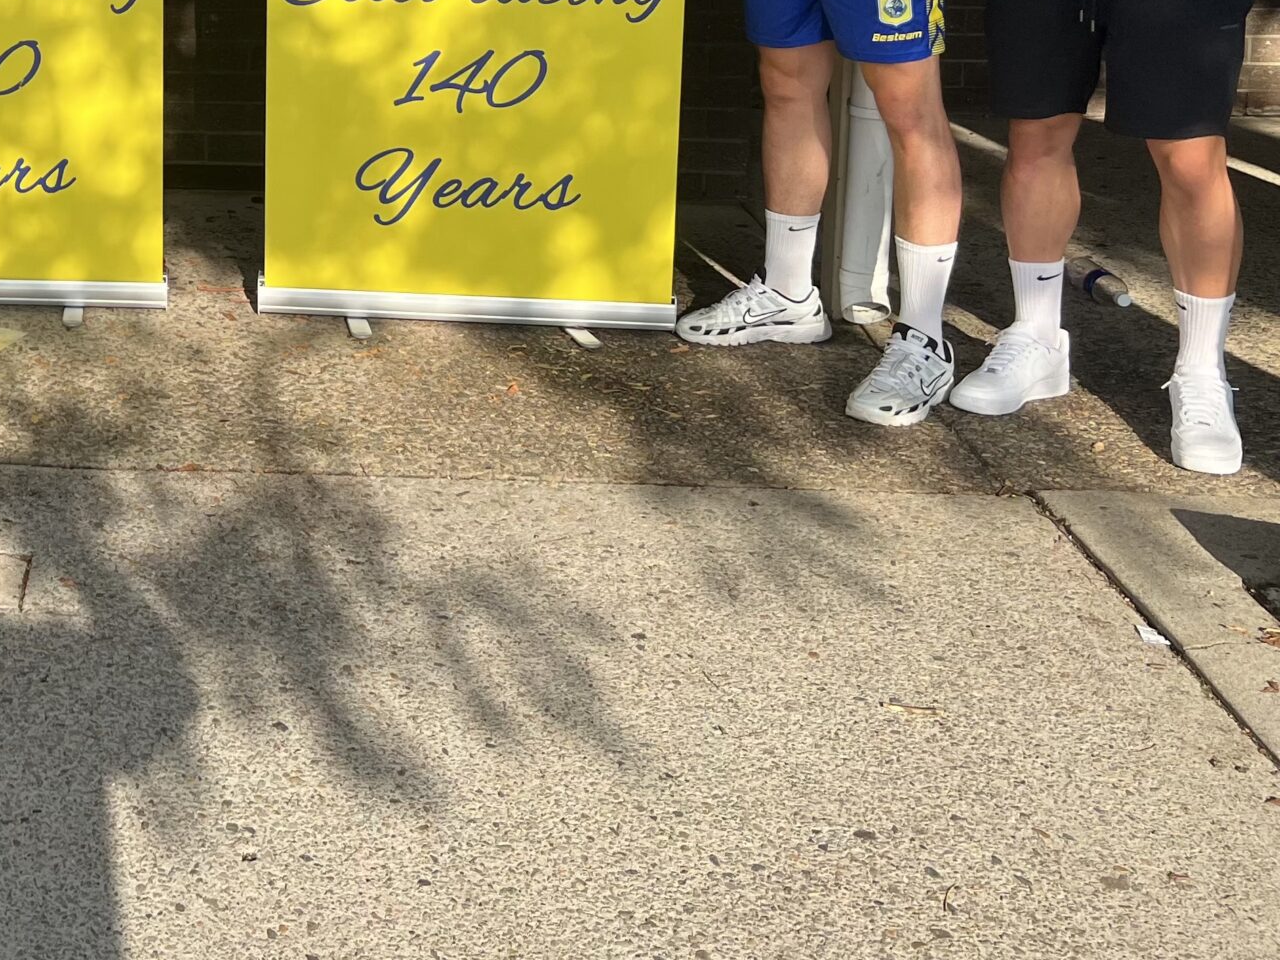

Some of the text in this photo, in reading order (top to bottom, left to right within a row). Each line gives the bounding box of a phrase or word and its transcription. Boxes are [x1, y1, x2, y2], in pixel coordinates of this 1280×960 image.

[871, 30, 923, 43] Besteam
[393, 49, 548, 114] 140
[354, 147, 582, 226] Years
